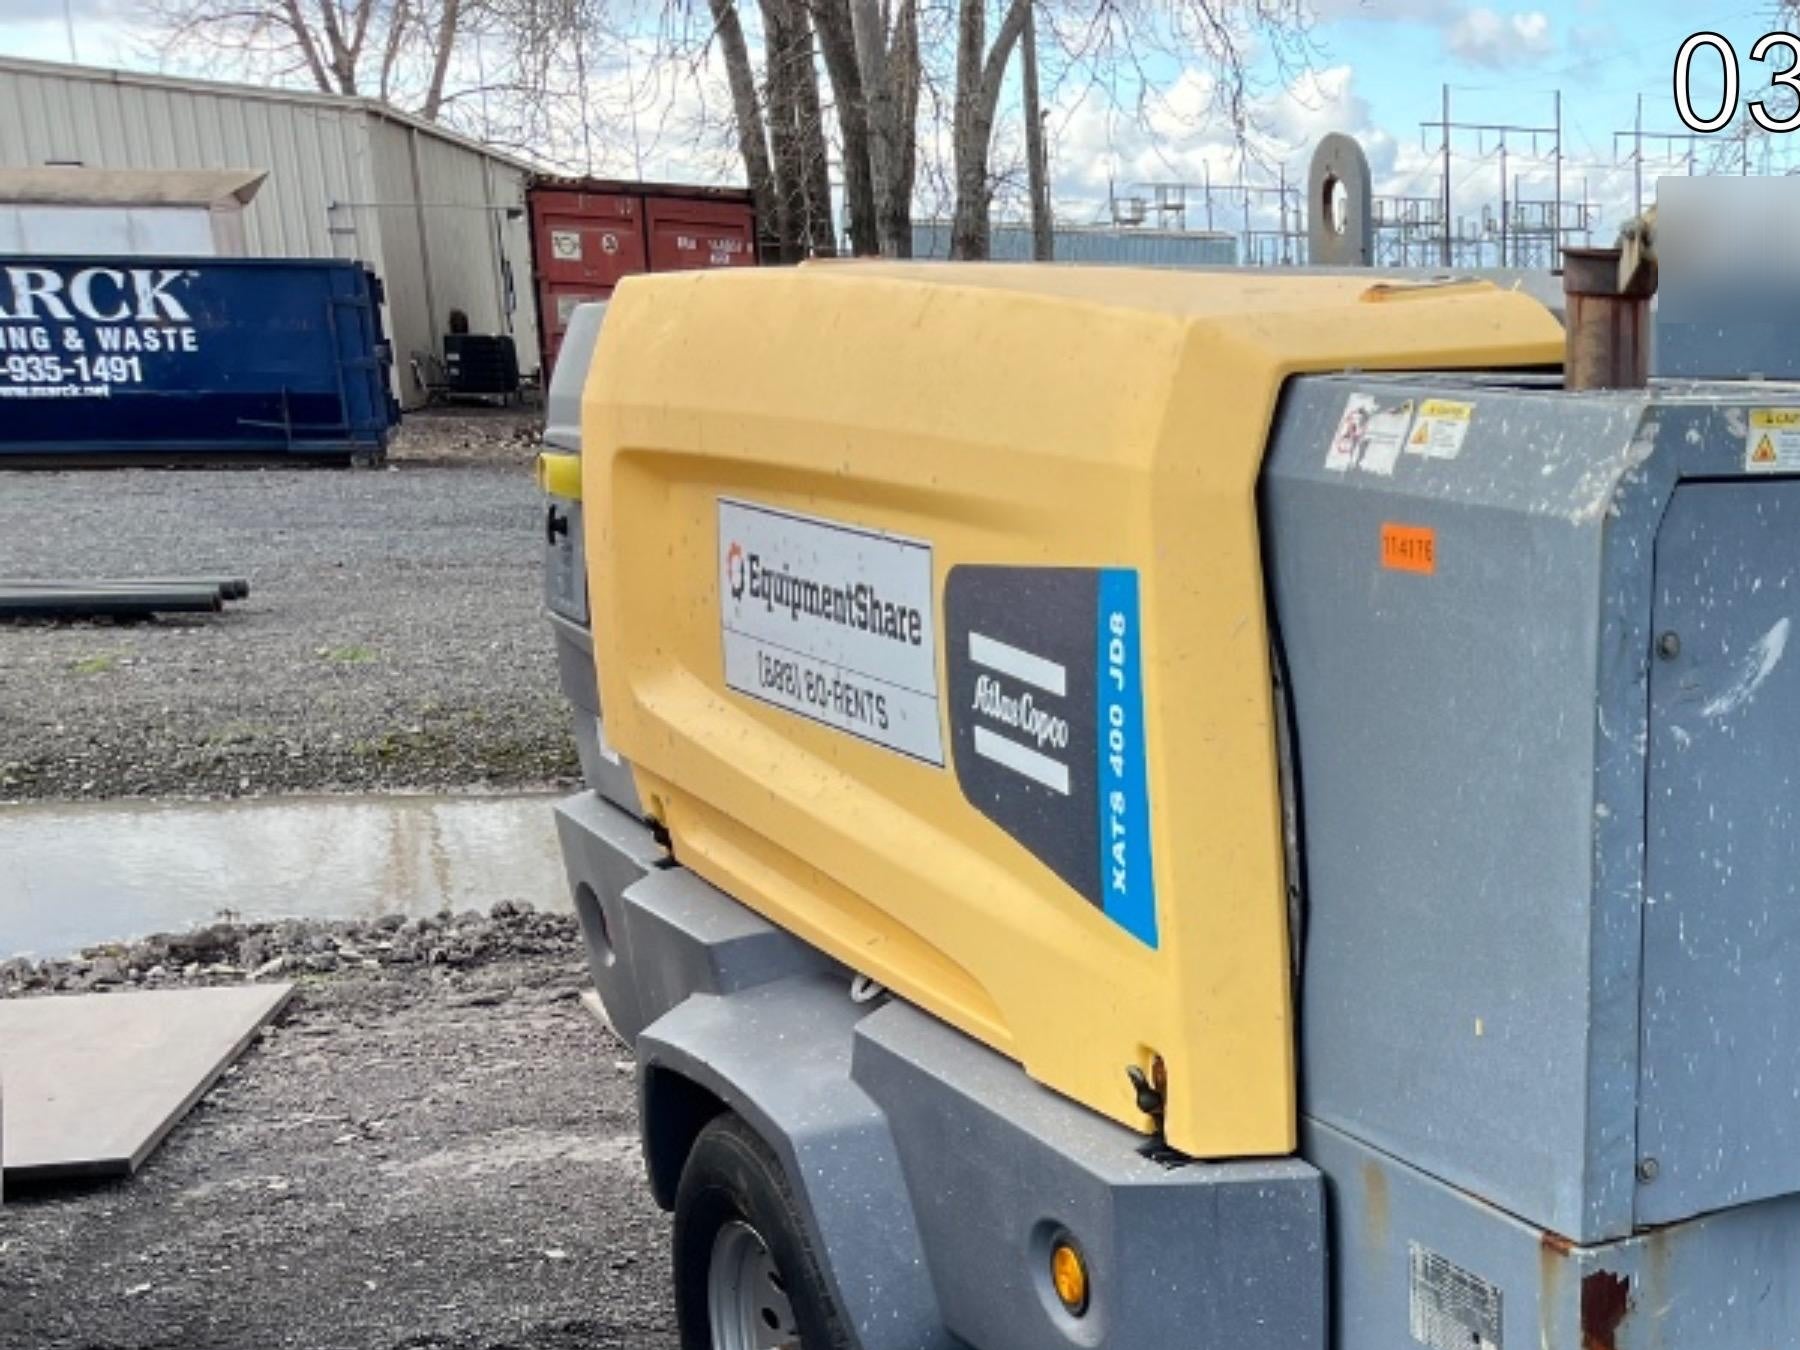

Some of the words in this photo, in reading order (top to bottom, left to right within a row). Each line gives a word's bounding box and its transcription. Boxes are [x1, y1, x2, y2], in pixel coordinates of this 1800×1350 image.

[0, 266, 191, 321] RCK
[63, 328, 84, 351] &
[96, 327, 198, 352] WASTE
[748, 553, 922, 646] EquipmentShare
[1109, 611, 1126, 692] JD8
[972, 674, 1018, 727] Atlas
[1020, 693, 1069, 748] Copco
[1109, 703, 1125, 778] 400
[1109, 790, 1126, 895] XATS
